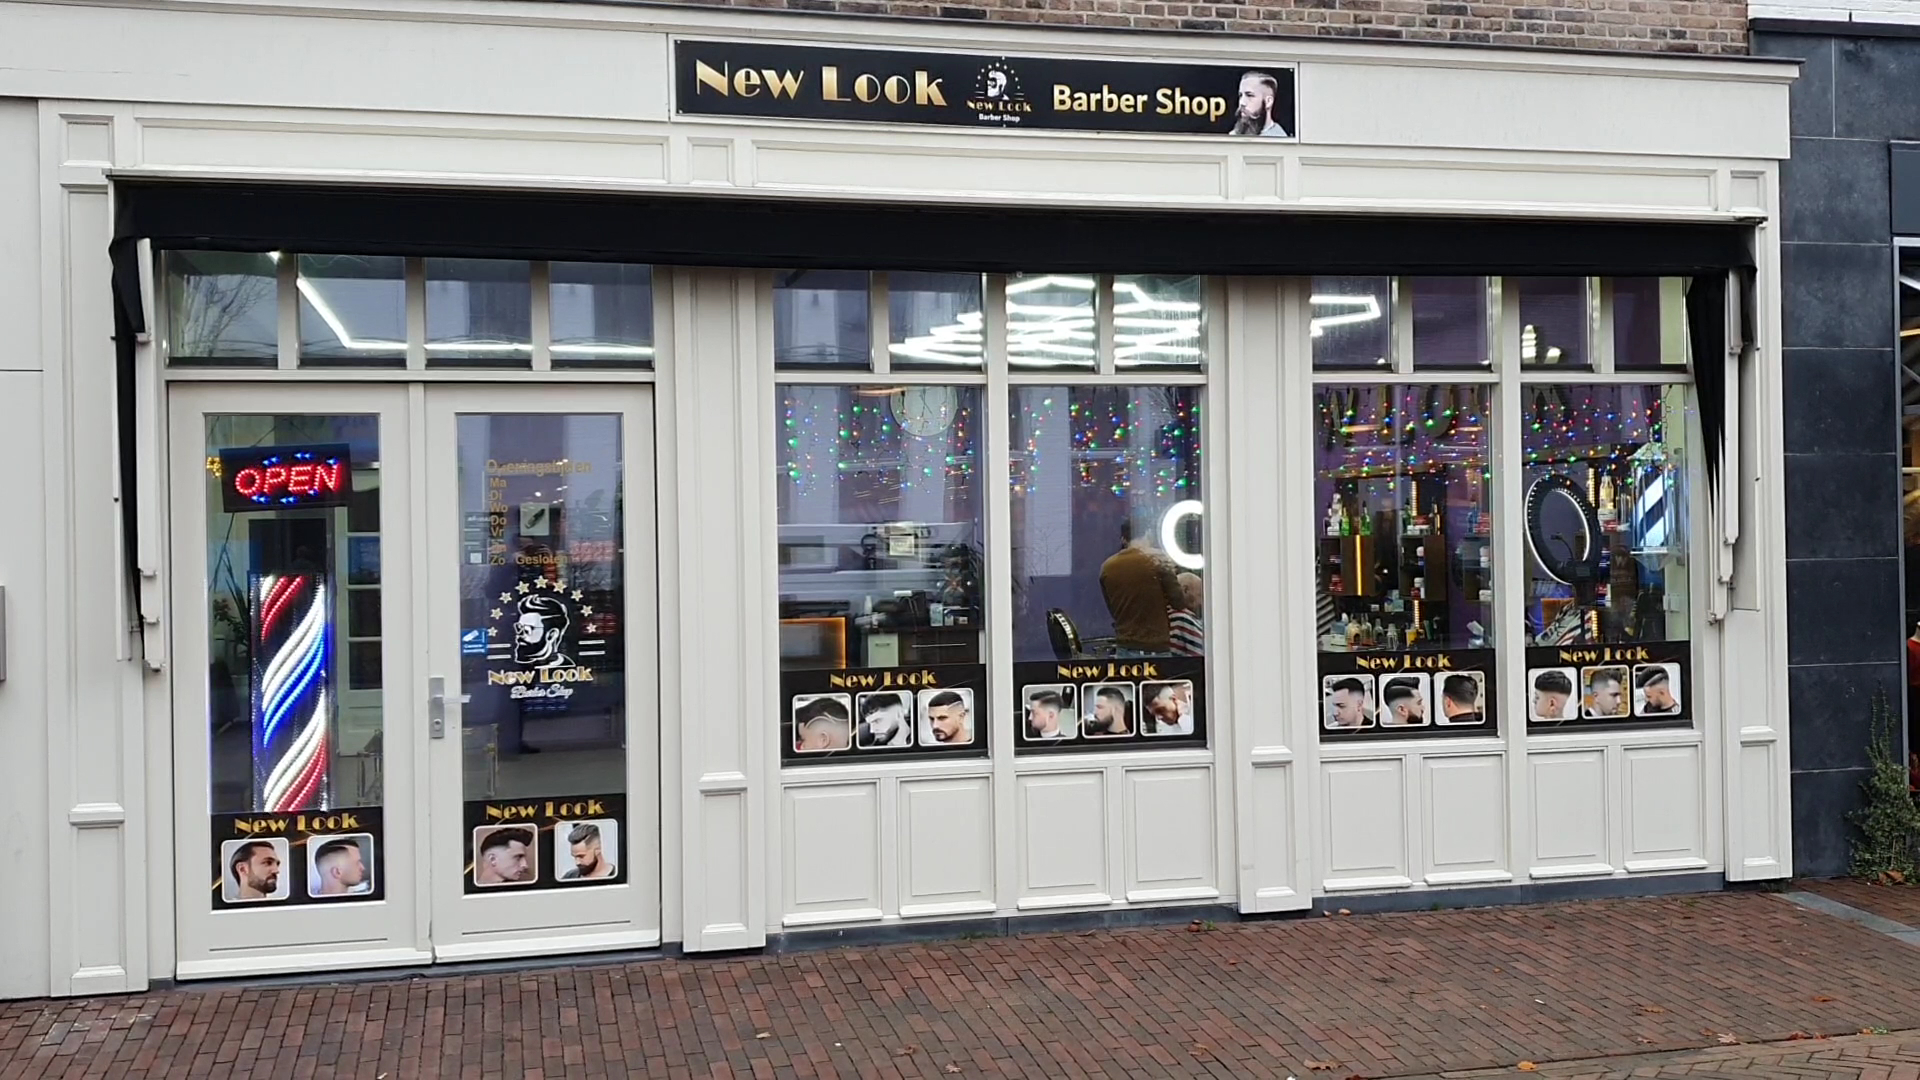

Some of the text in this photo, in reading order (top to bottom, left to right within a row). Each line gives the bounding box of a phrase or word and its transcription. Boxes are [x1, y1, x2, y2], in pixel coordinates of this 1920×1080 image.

[696, 59, 948, 106] New Look
[966, 100, 1032, 112] New Look
[1053, 84, 1227, 122] Barber Shop
[978, 113, 1021, 123] Barber Shop
[235, 464, 339, 496] OPEN
[489, 478, 507, 488] Ma
[490, 502, 508, 513] Wo
[491, 515, 507, 526] Do
[491, 526, 505, 537] Vr
[491, 554, 568, 566] Zo Gesloten
[1356, 653, 1452, 670] New Look
[1558, 646, 1650, 663] New Look
[487, 666, 594, 685] New Look
[829, 669, 937, 688] New Look
[1059, 662, 1159, 680] New Look
[486, 799, 605, 820] New Look
[234, 813, 360, 834] New Look
